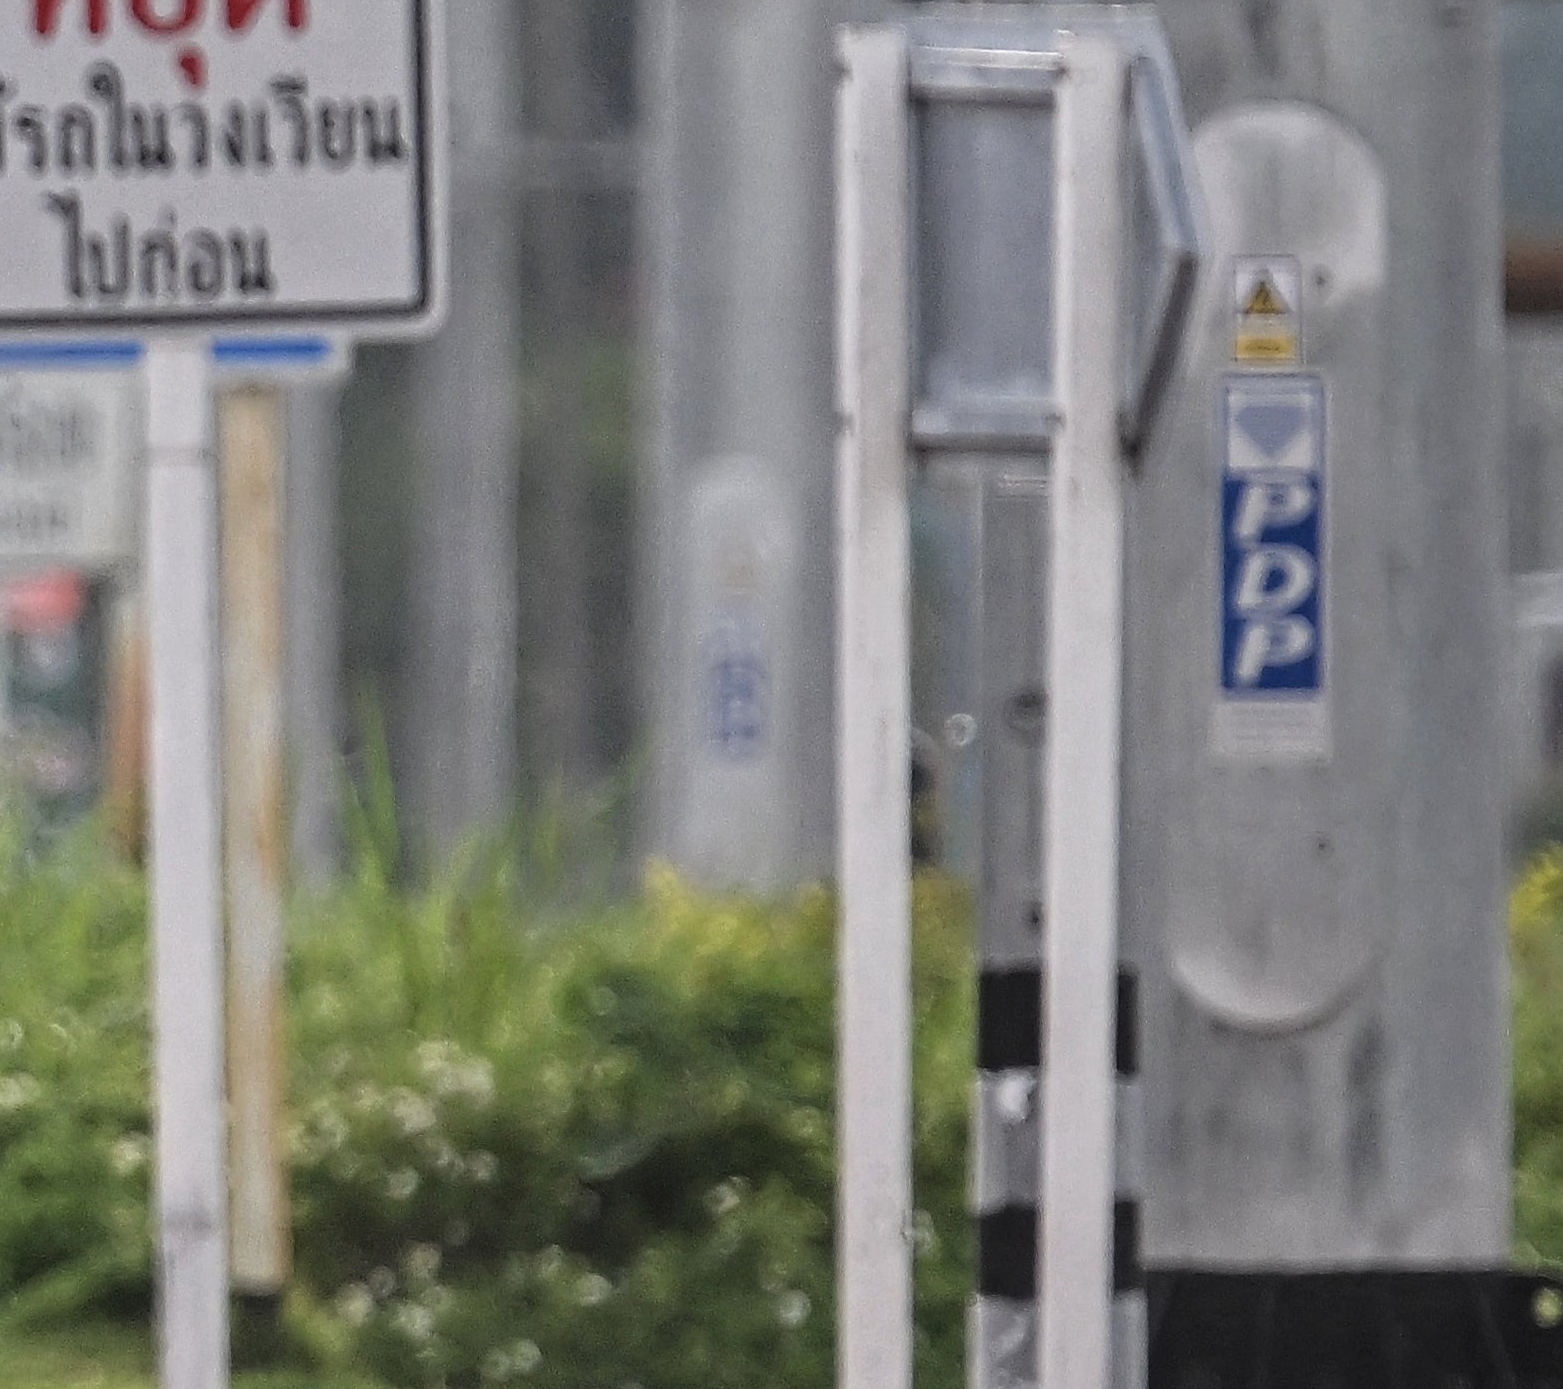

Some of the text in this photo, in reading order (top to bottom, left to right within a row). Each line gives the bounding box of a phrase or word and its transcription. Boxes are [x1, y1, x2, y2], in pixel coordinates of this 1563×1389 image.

[47, 189, 277, 301] ไปก่อน
[1233, 475, 1316, 689] PDP
